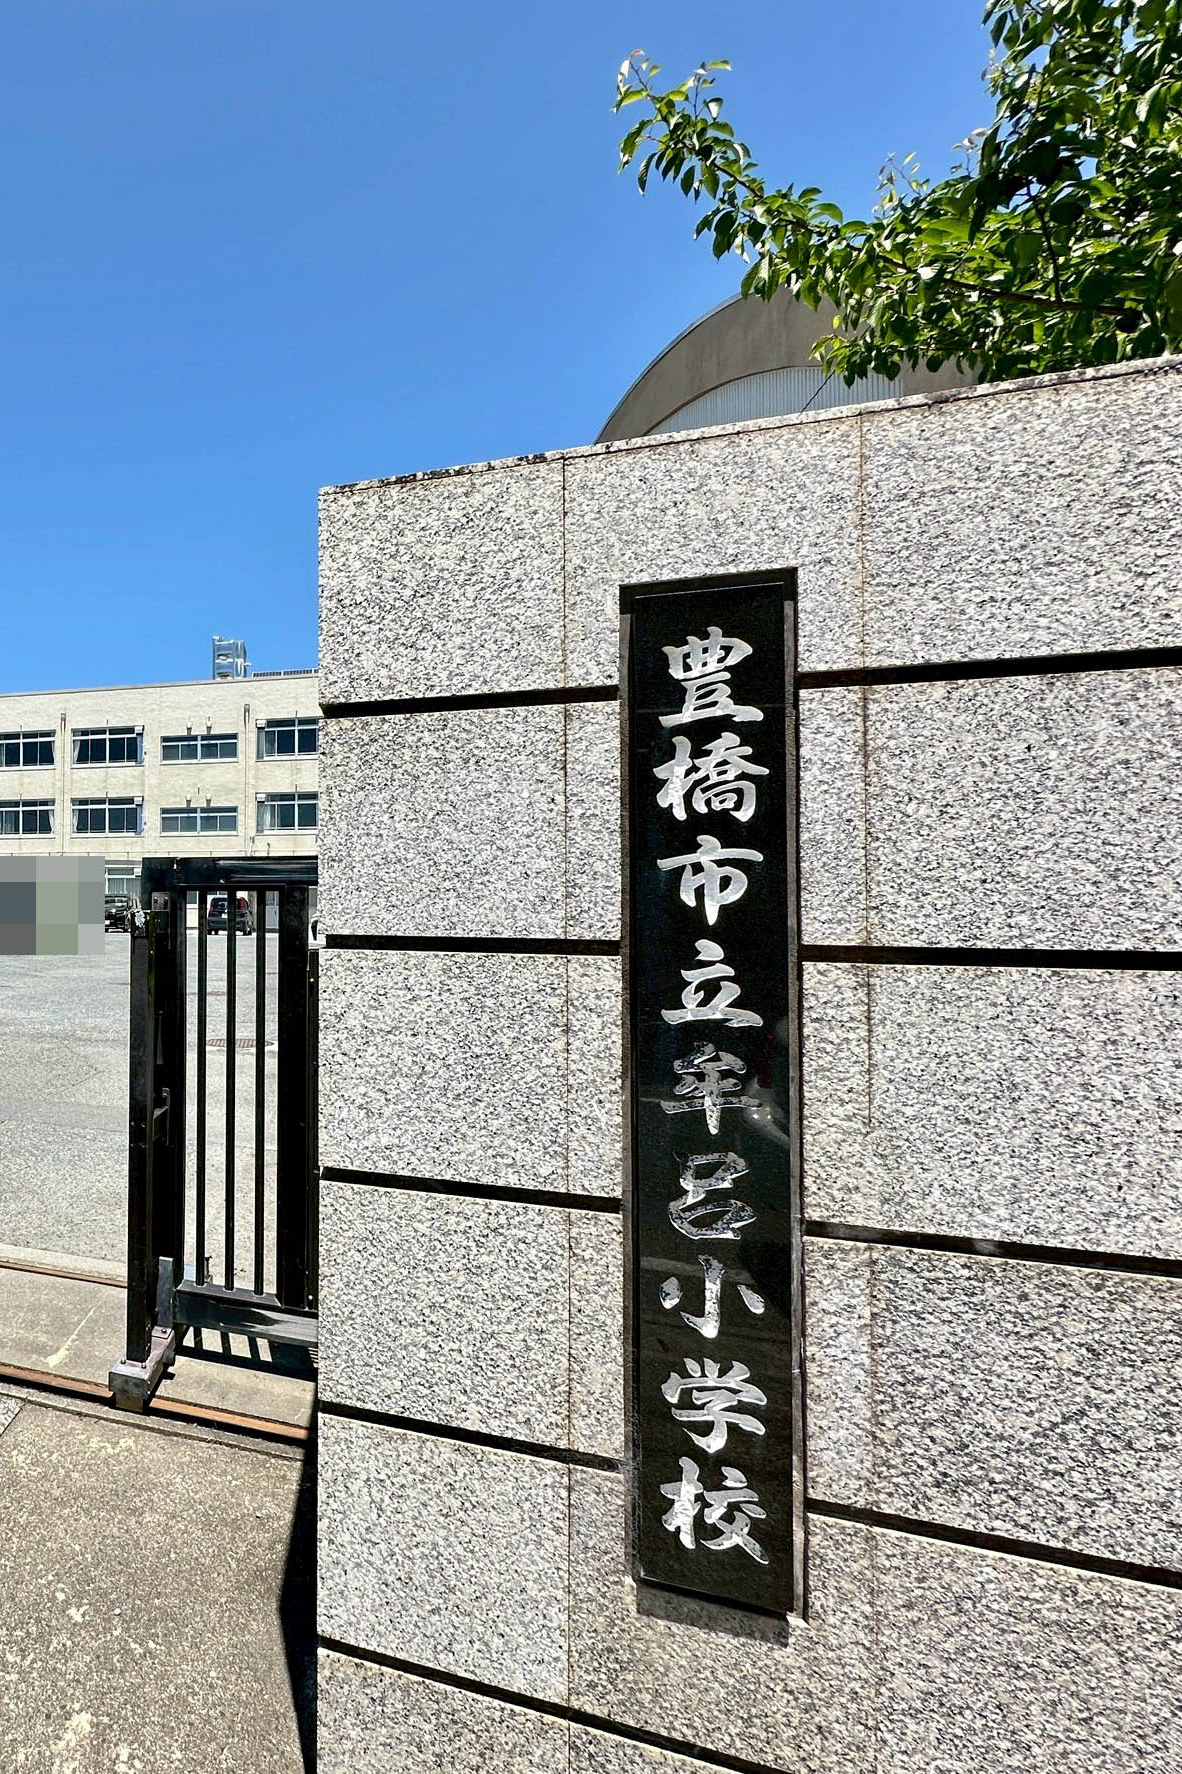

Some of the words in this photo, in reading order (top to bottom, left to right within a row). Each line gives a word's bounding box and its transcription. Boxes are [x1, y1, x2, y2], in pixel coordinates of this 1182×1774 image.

[654, 626, 769, 1564] 豊橋市立牟呂小学校
